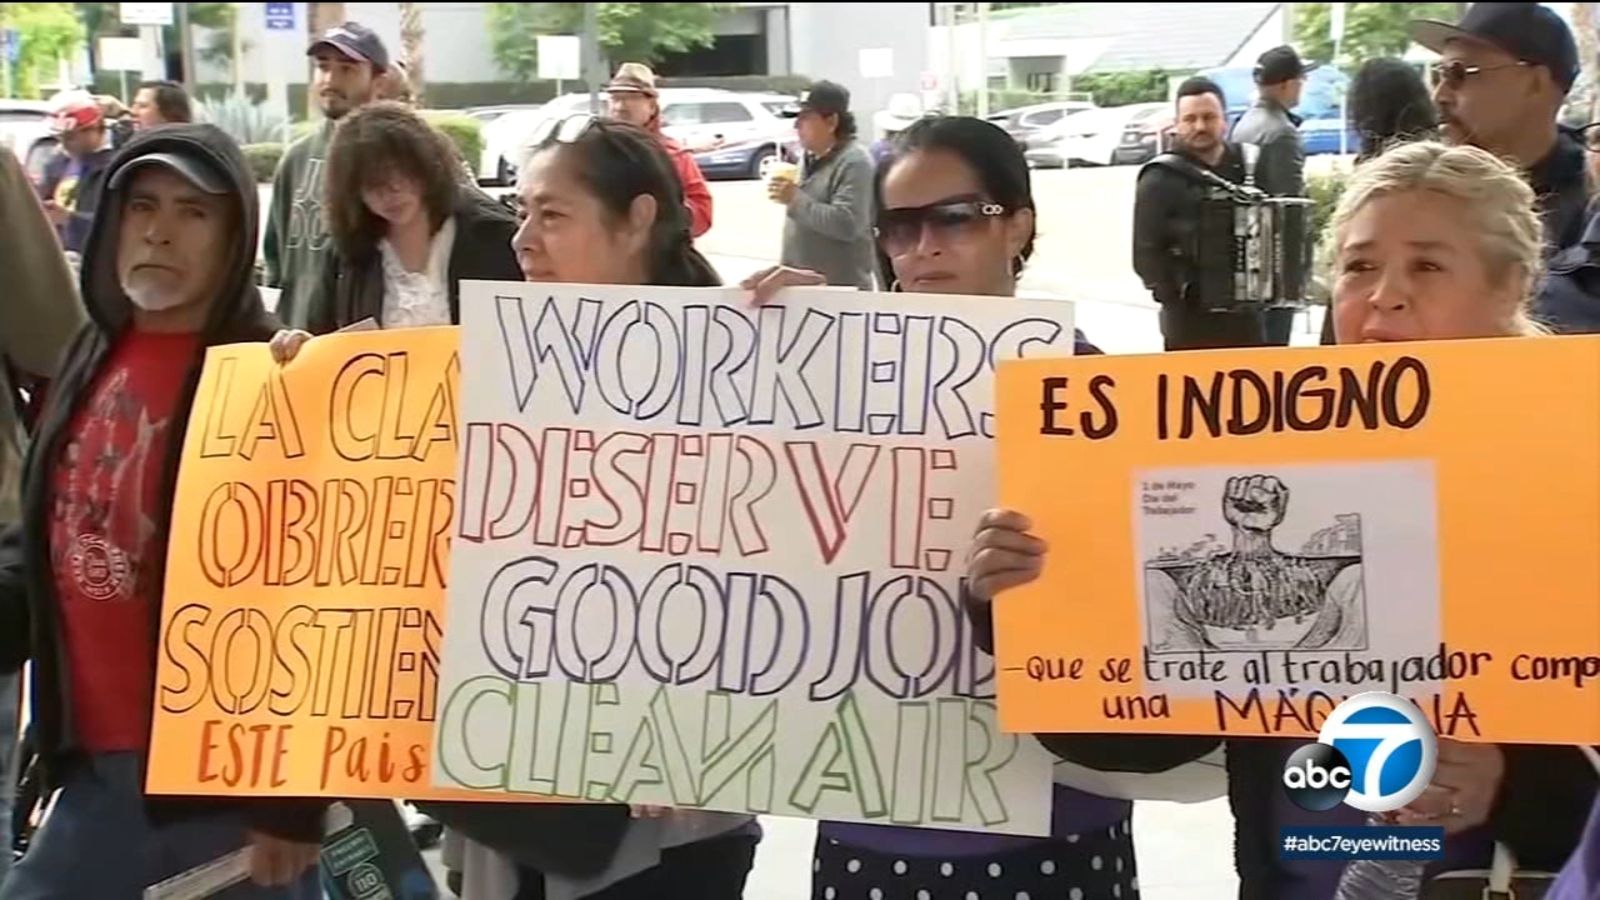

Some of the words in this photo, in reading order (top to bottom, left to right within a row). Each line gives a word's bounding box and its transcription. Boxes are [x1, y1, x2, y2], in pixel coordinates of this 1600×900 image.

[200, 356, 305, 460] LA
[1040, 375, 1118, 440] ES
[1156, 356, 1432, 440] INDIGNO
[460, 423, 956, 571] DESERVE
[481, 556, 811, 695] GOOD
[1100, 657, 1132, 683] se
[1144, 645, 1228, 682] trate
[1243, 651, 1270, 685] al
[1281, 642, 1492, 694] trabajador
[438, 675, 778, 813] CLEAN
[789, 688, 1018, 826] AIR
[1103, 693, 1170, 720] una
[199, 720, 294, 788] ESTE
[320, 725, 427, 790] Pais
